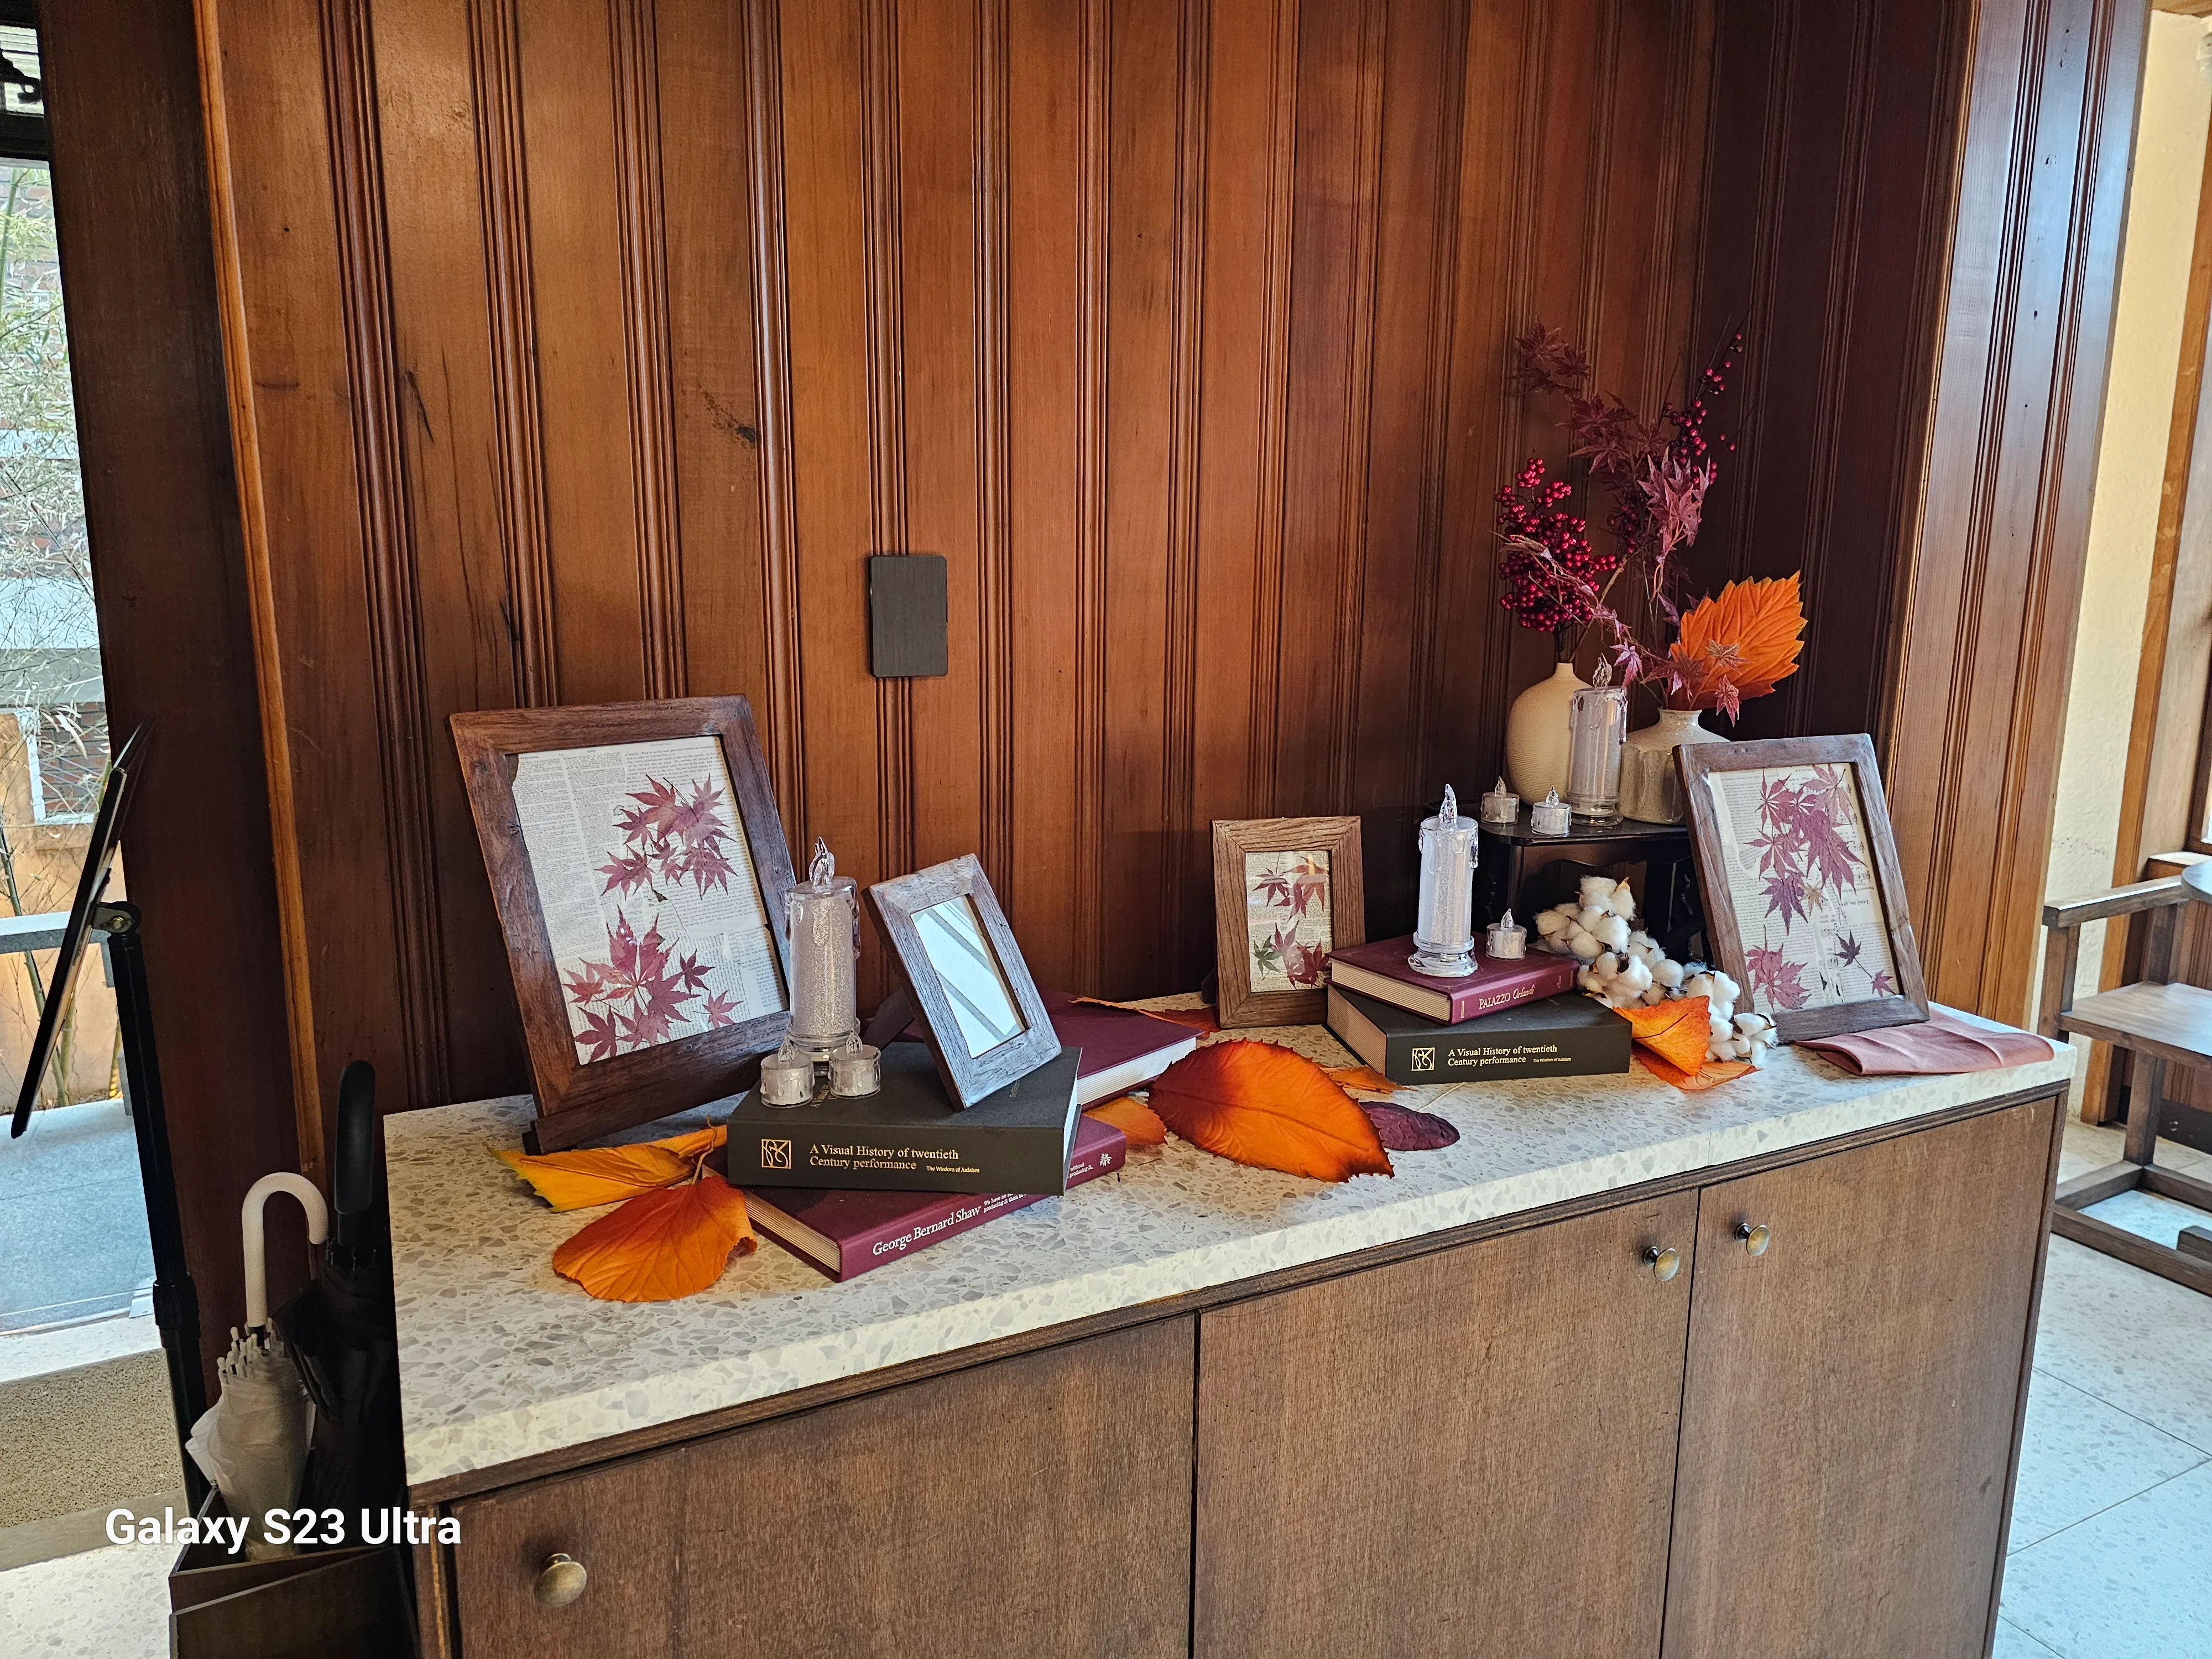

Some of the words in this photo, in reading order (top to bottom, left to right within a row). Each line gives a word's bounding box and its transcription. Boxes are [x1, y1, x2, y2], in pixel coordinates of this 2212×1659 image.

[1479, 993, 1511, 1010] PALAZZO
[1448, 1048, 1455, 1057] A
[1457, 1047, 1481, 1056] Visual
[1483, 1047, 1511, 1056] History
[1512, 1046, 1522, 1054] of
[1523, 1044, 1557, 1054] twentieth
[1448, 1058, 1478, 1067] Century
[1479, 1056, 1526, 1067] performance
[809, 1144, 819, 1154] A
[821, 1144, 854, 1155] Visual
[856, 1145, 894, 1159] History
[897, 1147, 910, 1157] of
[911, 1149, 959, 1160] twentieth
[810, 1156, 851, 1170] Century
[853, 1158, 917, 1170] performance
[872, 1234, 912, 1255] George
[912, 1212, 954, 1240] Bernard
[955, 1206, 982, 1224] Shaw
